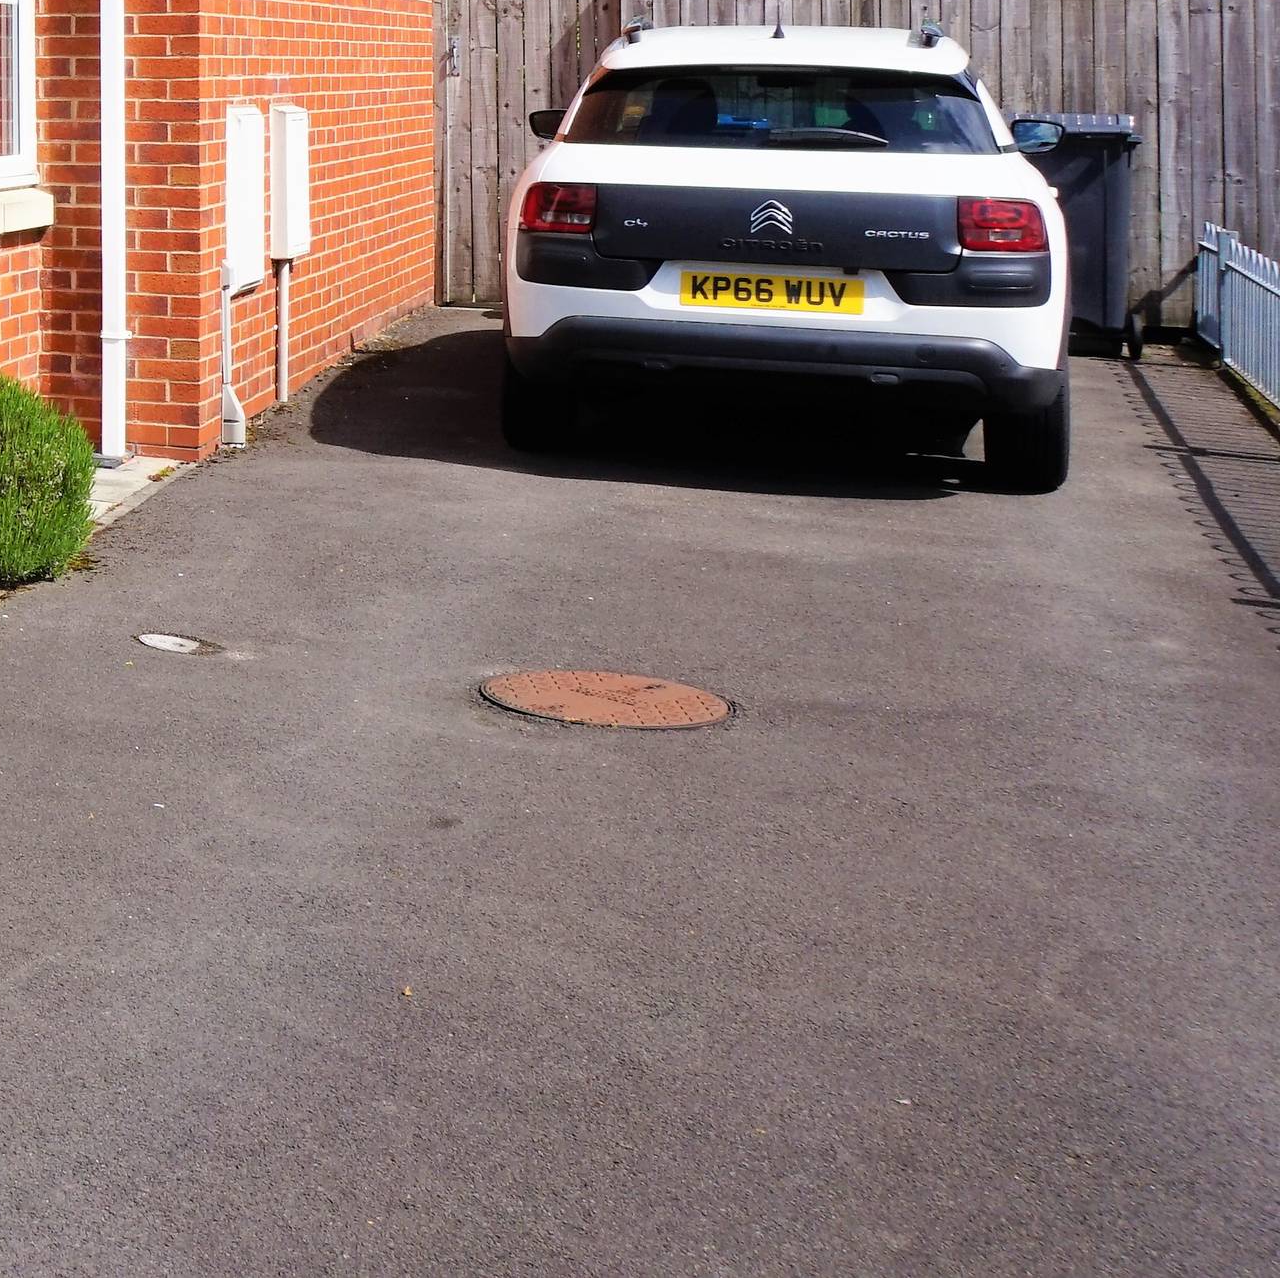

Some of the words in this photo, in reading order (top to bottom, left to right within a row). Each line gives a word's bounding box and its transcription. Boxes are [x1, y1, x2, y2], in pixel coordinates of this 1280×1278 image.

[863, 229, 930, 240] CACTUS
[691, 275, 774, 303] KP66
[785, 279, 847, 307] WUV
